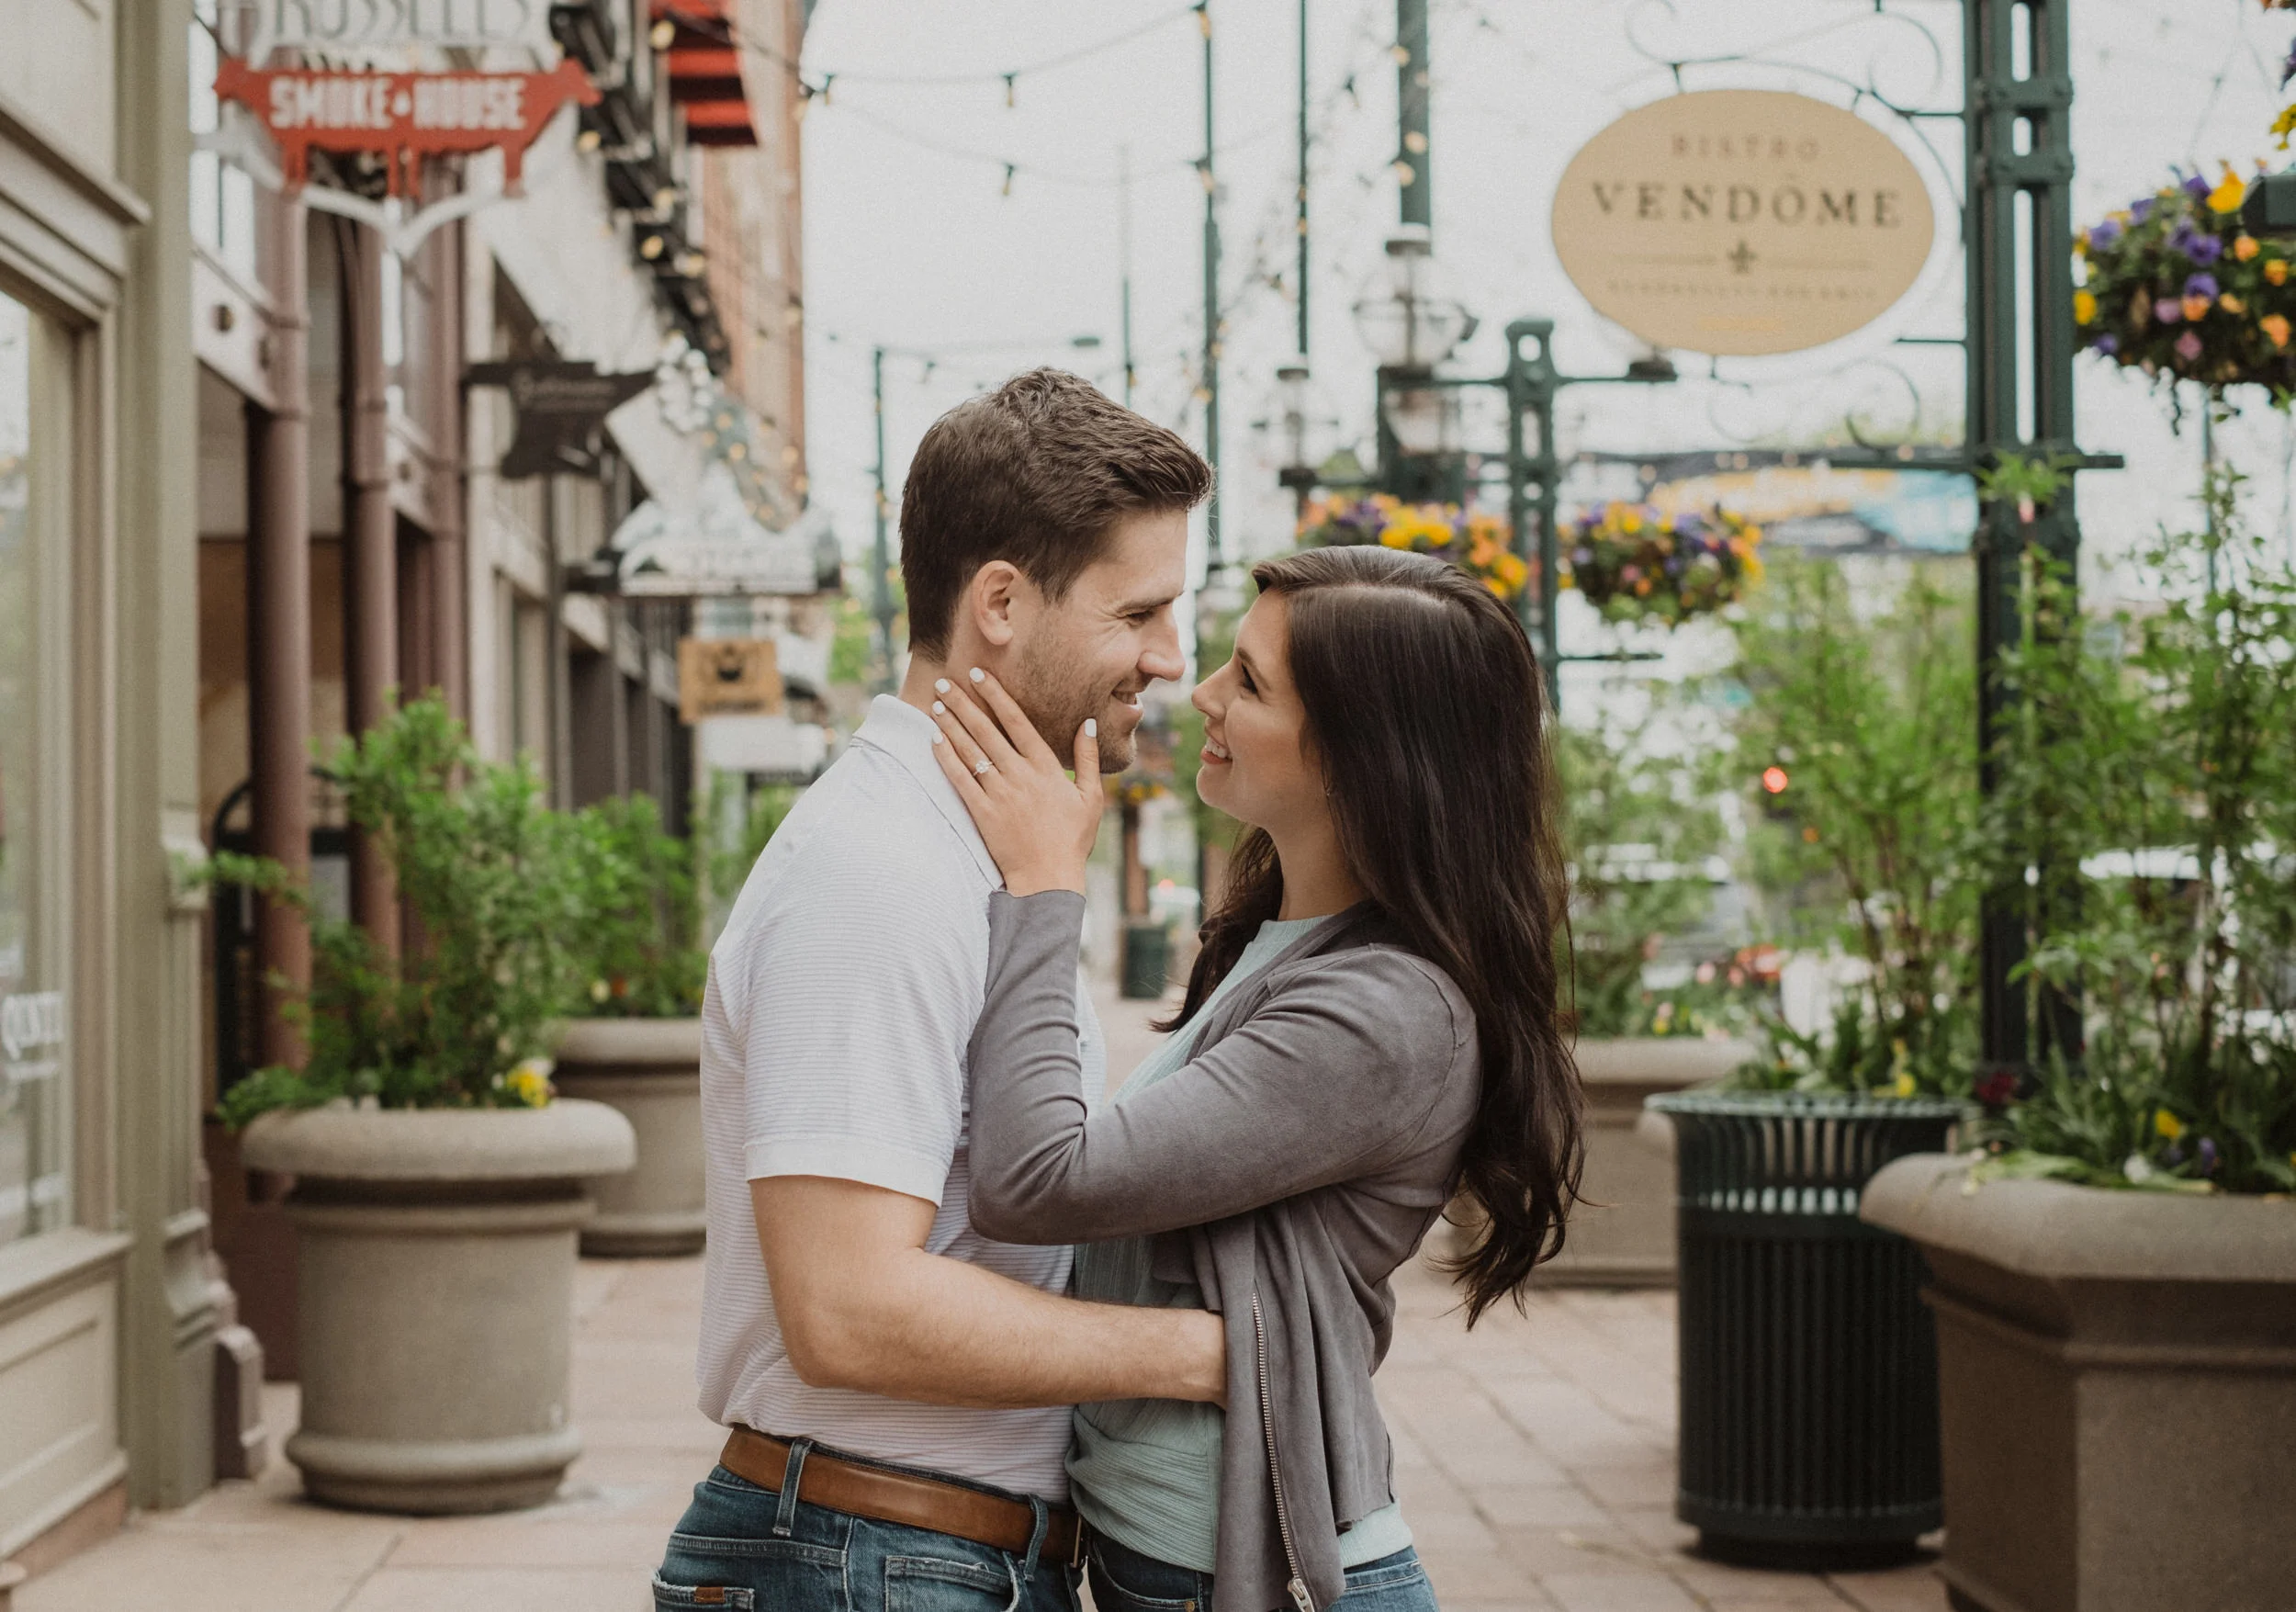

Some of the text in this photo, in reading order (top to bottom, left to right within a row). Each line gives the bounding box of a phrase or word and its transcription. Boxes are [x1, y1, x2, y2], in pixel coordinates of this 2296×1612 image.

[270, 76, 526, 130] SMOKE HOUSE
[1671, 133, 1820, 162] BISTRO
